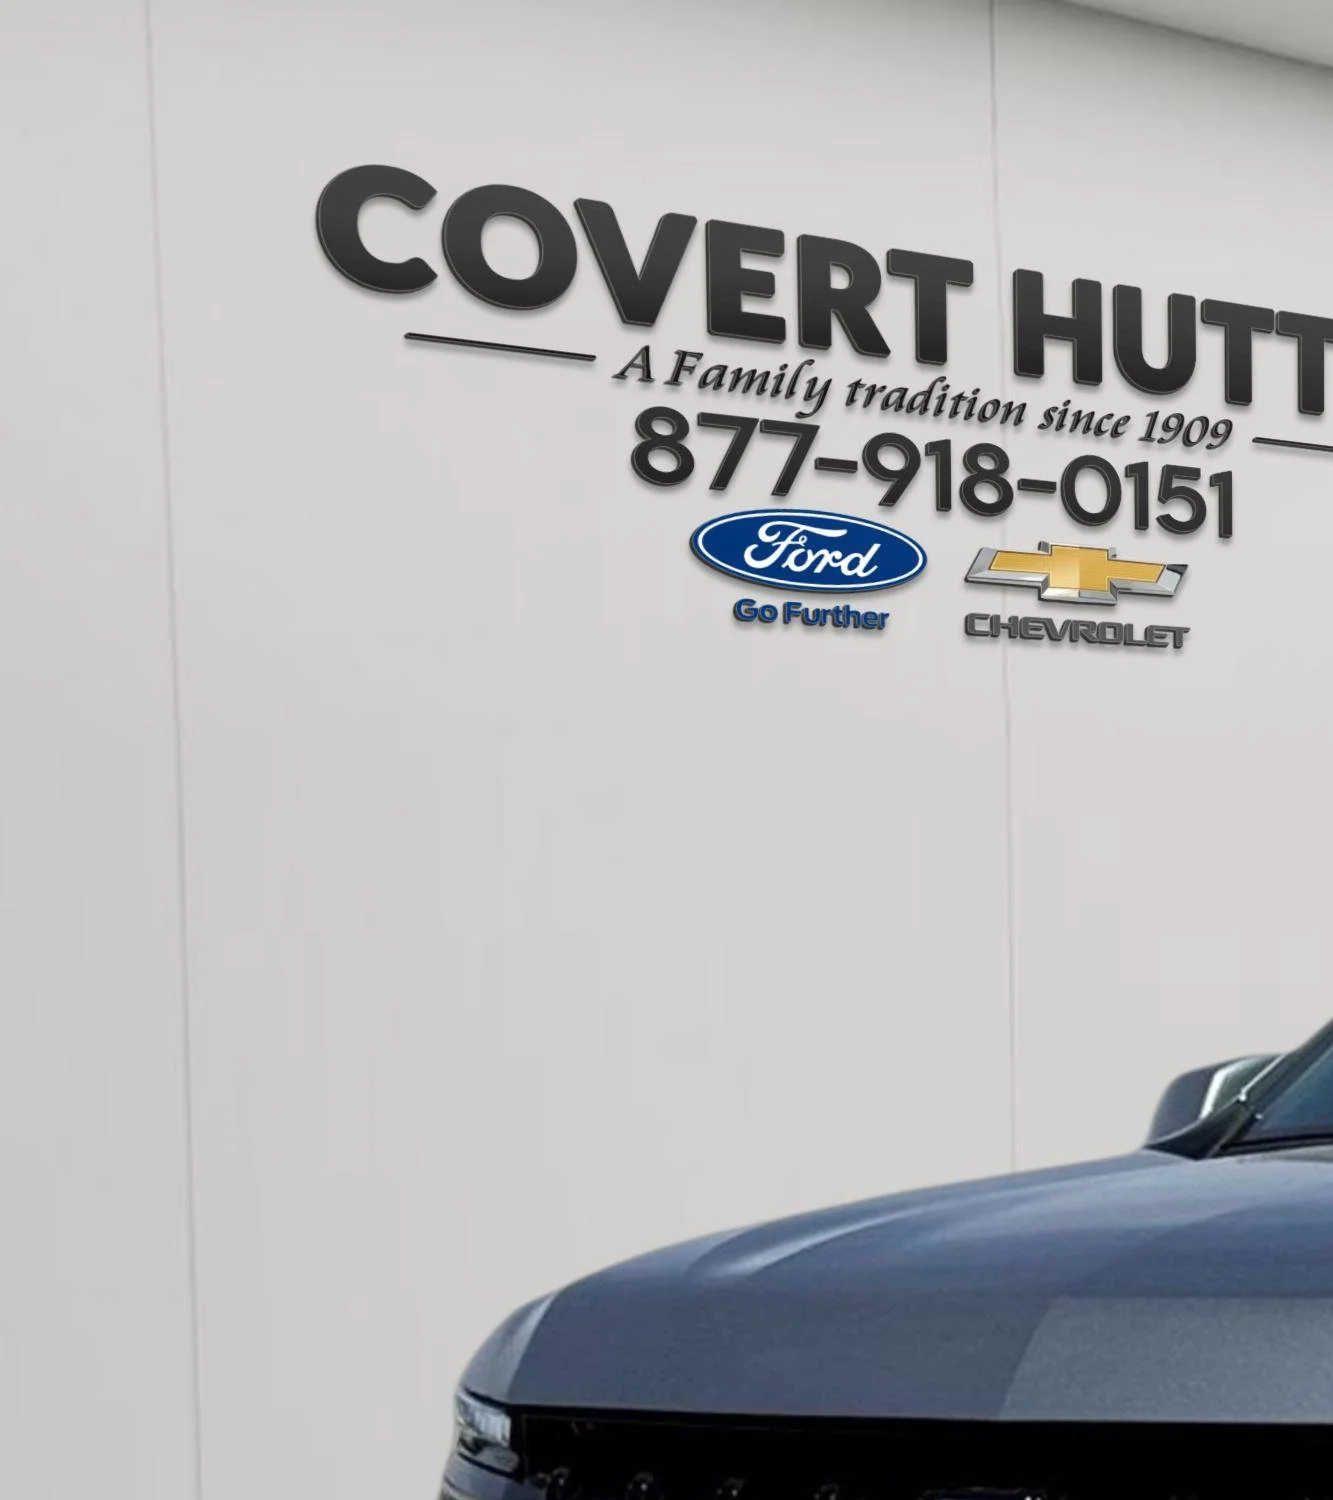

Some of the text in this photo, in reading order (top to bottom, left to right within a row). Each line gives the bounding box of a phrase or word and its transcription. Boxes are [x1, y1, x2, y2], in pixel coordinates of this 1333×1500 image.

[315, 164, 974, 367] COVERT
[611, 345, 1234, 450] A Family tradition since 1909
[630, 406, 1233, 540] 877-918-0151
[744, 520, 881, 579] Ford
[732, 598, 891, 631] Go Further
[964, 612, 1191, 650] CHEVROLET
